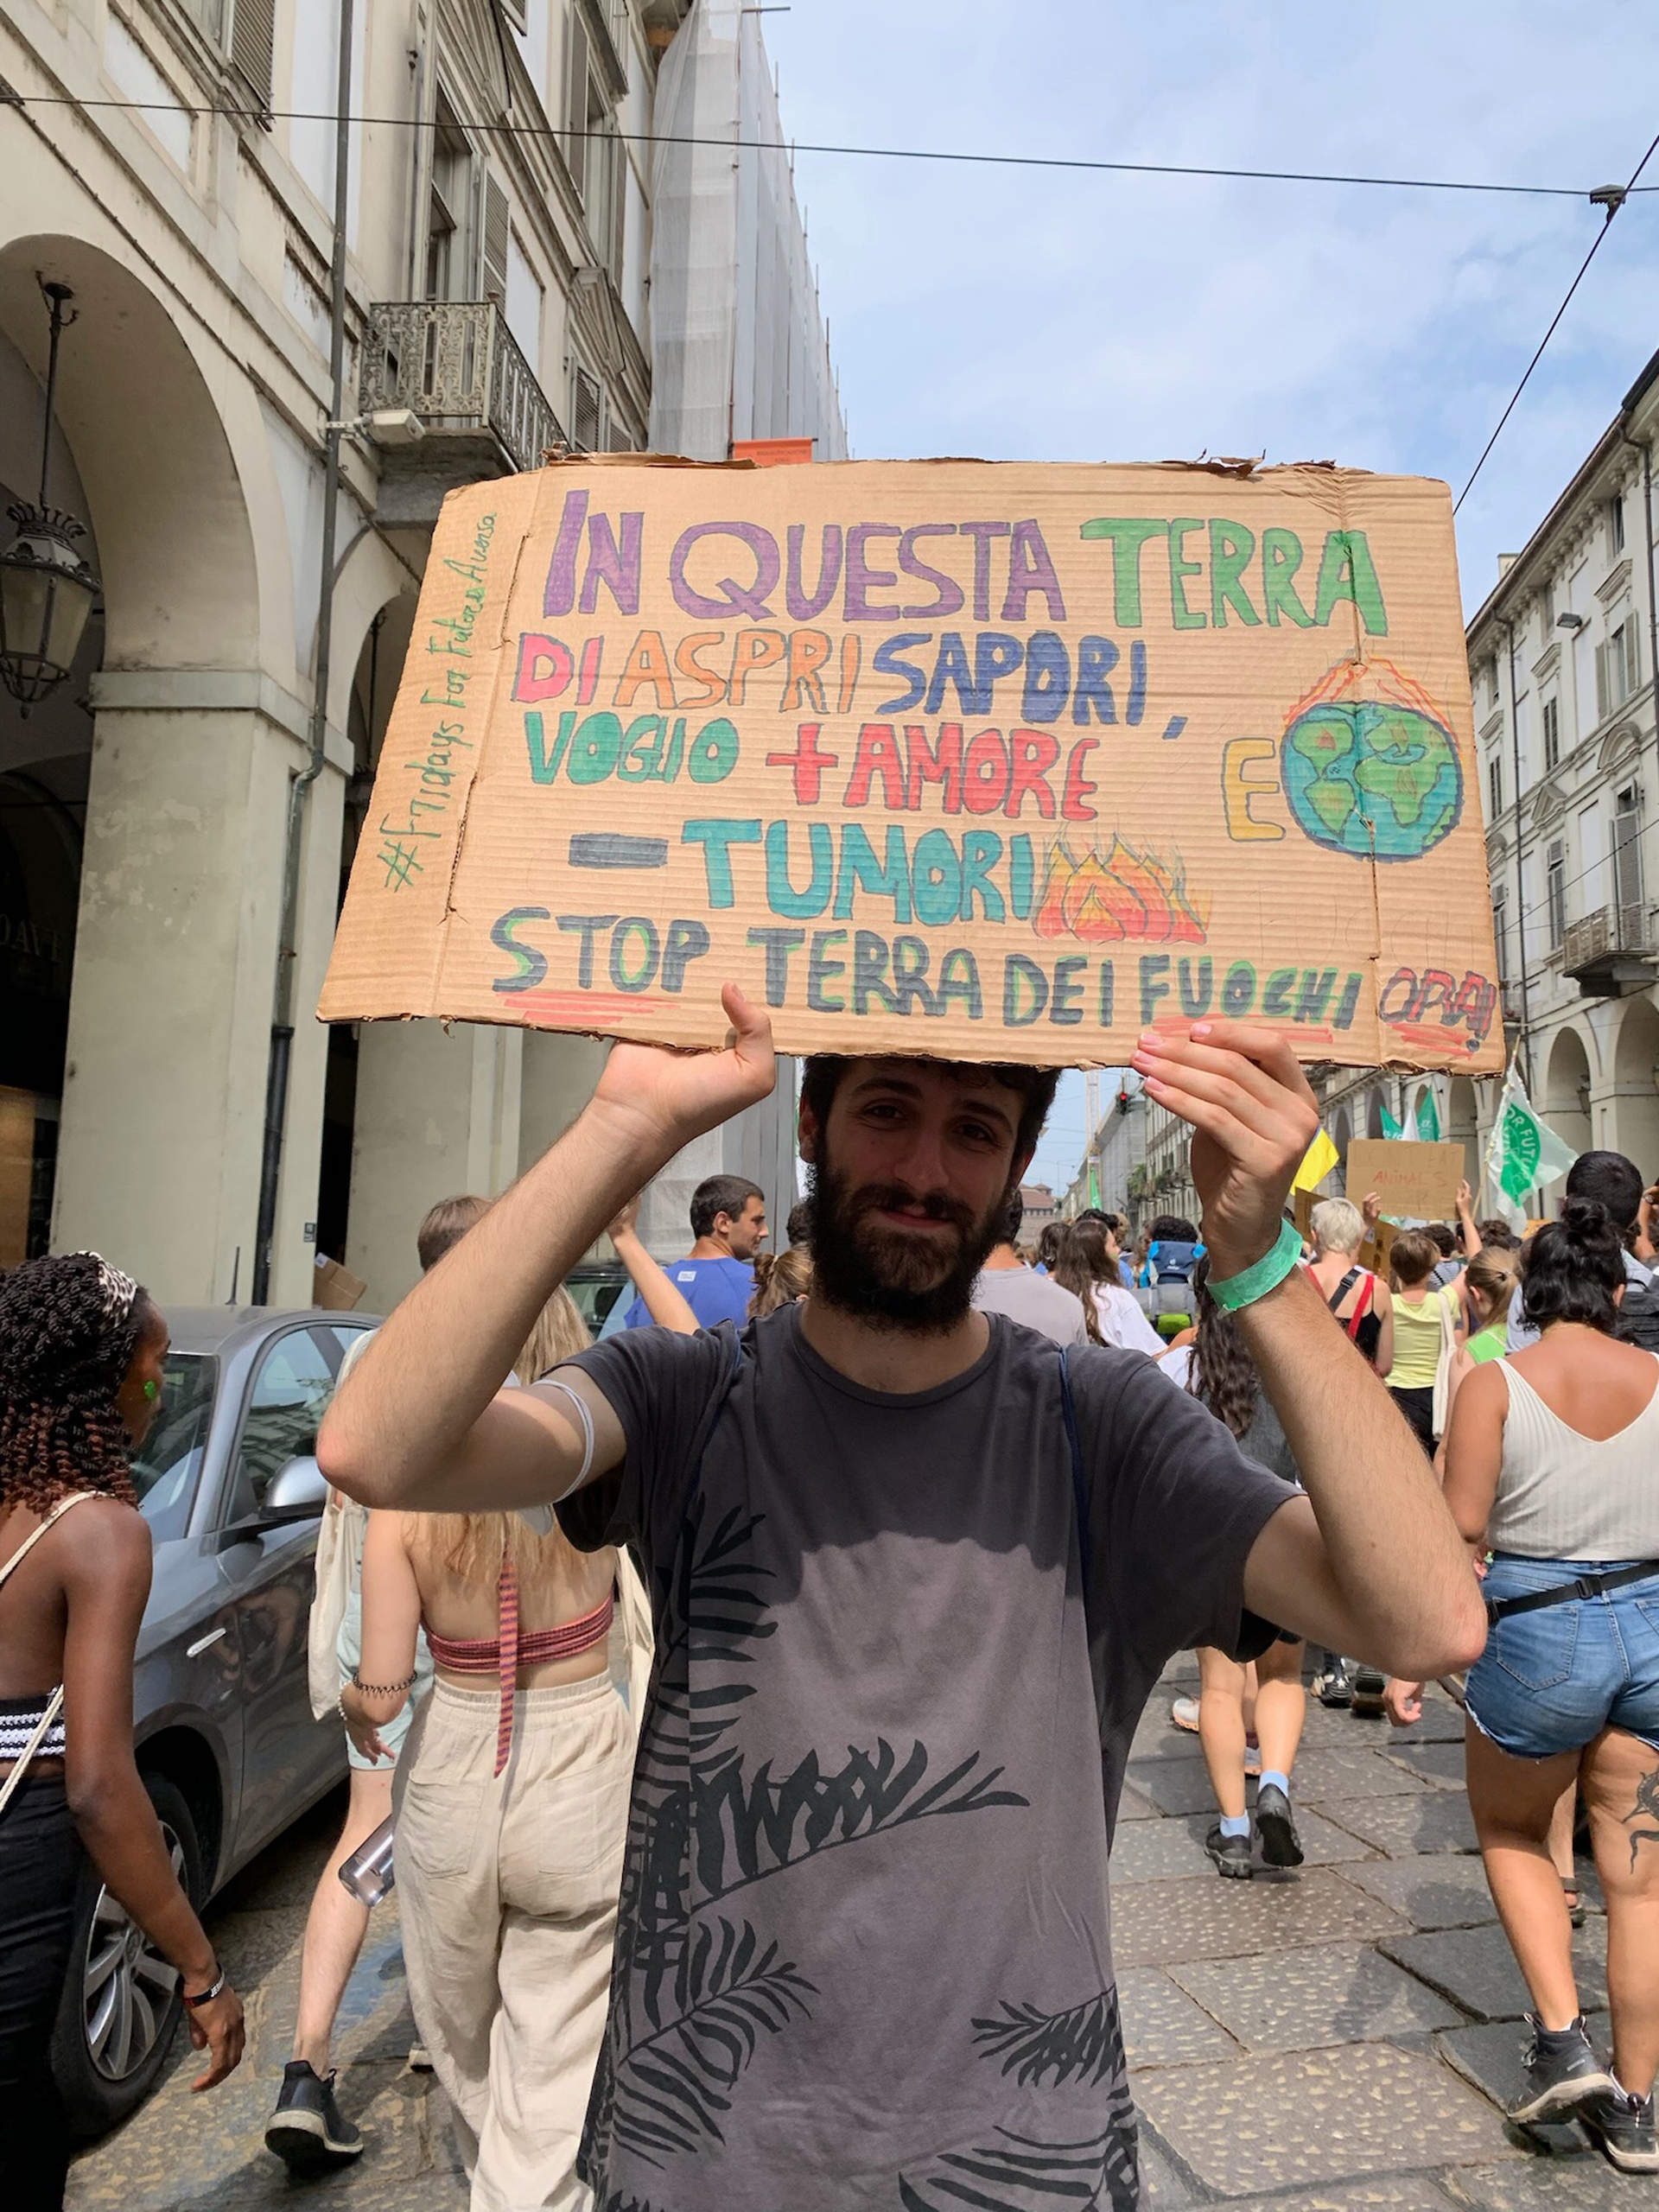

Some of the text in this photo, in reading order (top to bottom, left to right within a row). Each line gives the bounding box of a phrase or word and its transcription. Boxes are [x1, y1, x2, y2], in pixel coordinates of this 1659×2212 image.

[543, 489, 1389, 637] IN QUESTA TERRA
[511, 628, 1188, 741] DI ASPRI SAPORI,
[842, 721, 1101, 822] AMORE
[1221, 737, 1287, 843] E
[681, 819, 1035, 926] TUMORI
[490, 906, 1498, 1053] STOP TERRA DEI FUOCHI ORA!
